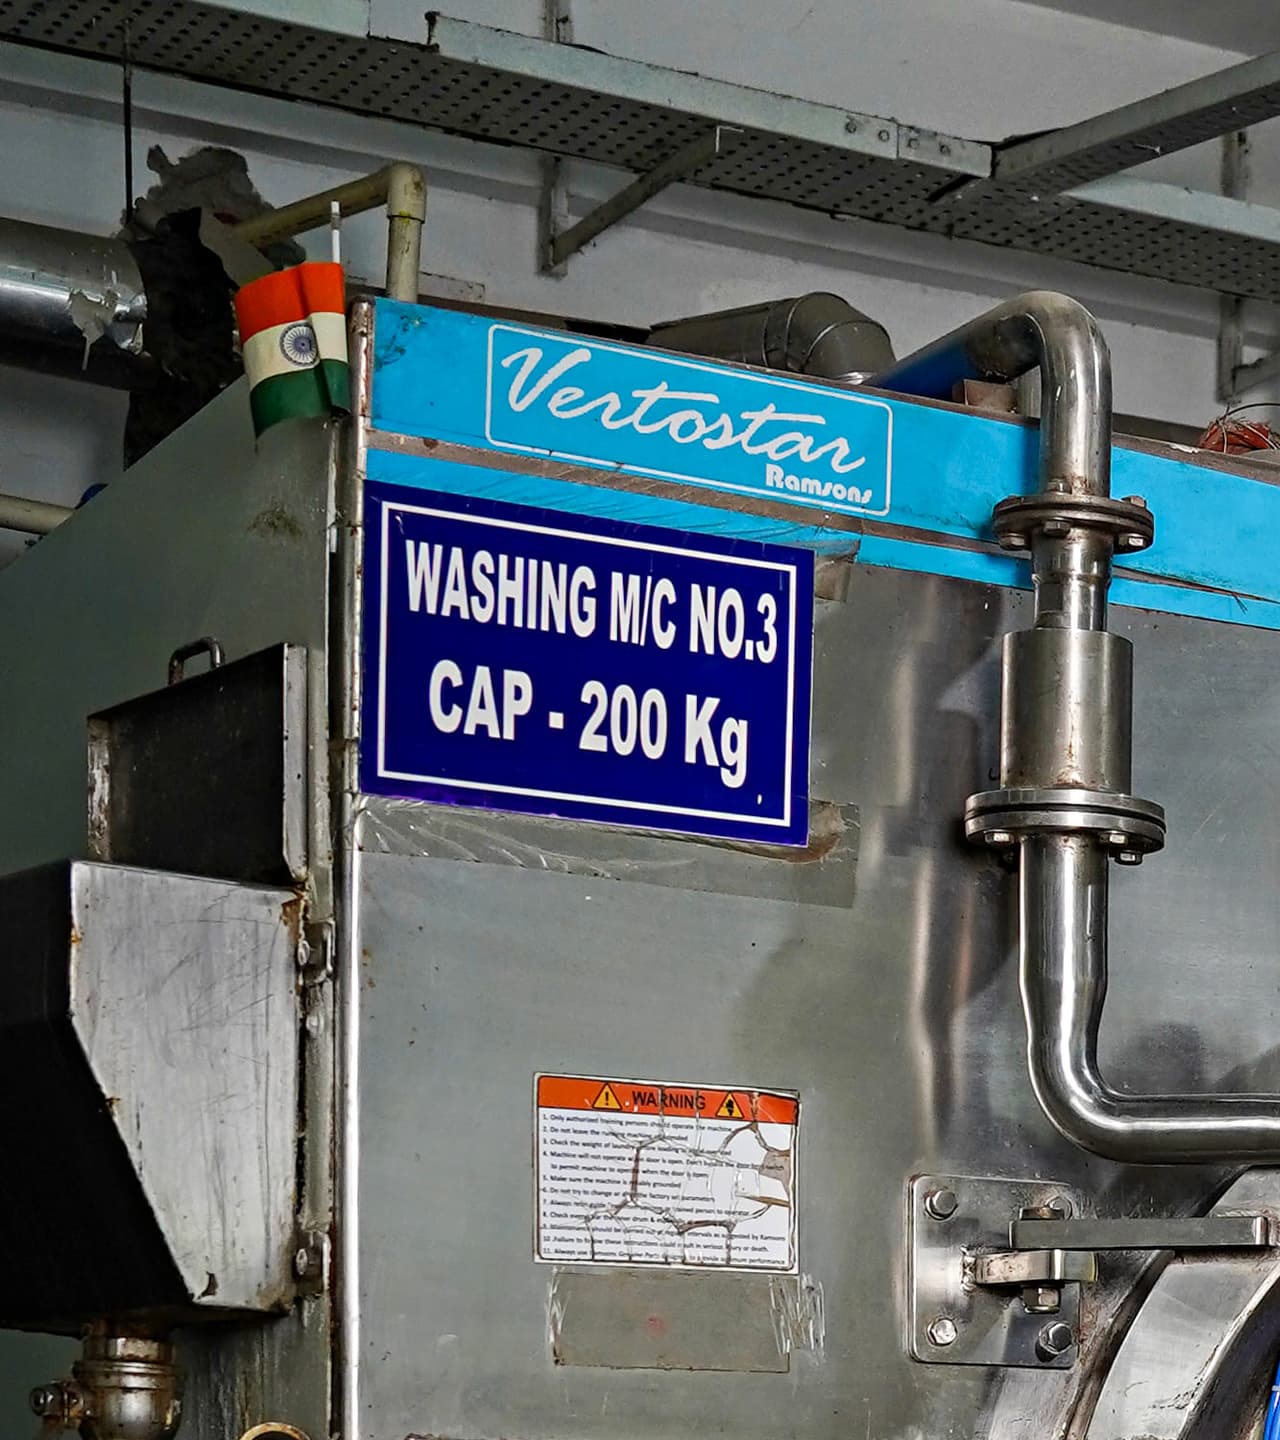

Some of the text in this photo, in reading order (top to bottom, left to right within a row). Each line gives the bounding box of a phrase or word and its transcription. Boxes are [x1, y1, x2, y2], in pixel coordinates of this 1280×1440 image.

[501, 347, 866, 472] Vertostar
[765, 464, 875, 506] Ramsons
[405, 540, 778, 663] WASHING M/C NO.3
[429, 660, 534, 741] CAP
[579, 680, 668, 760] 200
[684, 695, 749, 788] Kg
[632, 1090, 706, 1110] WARNING
